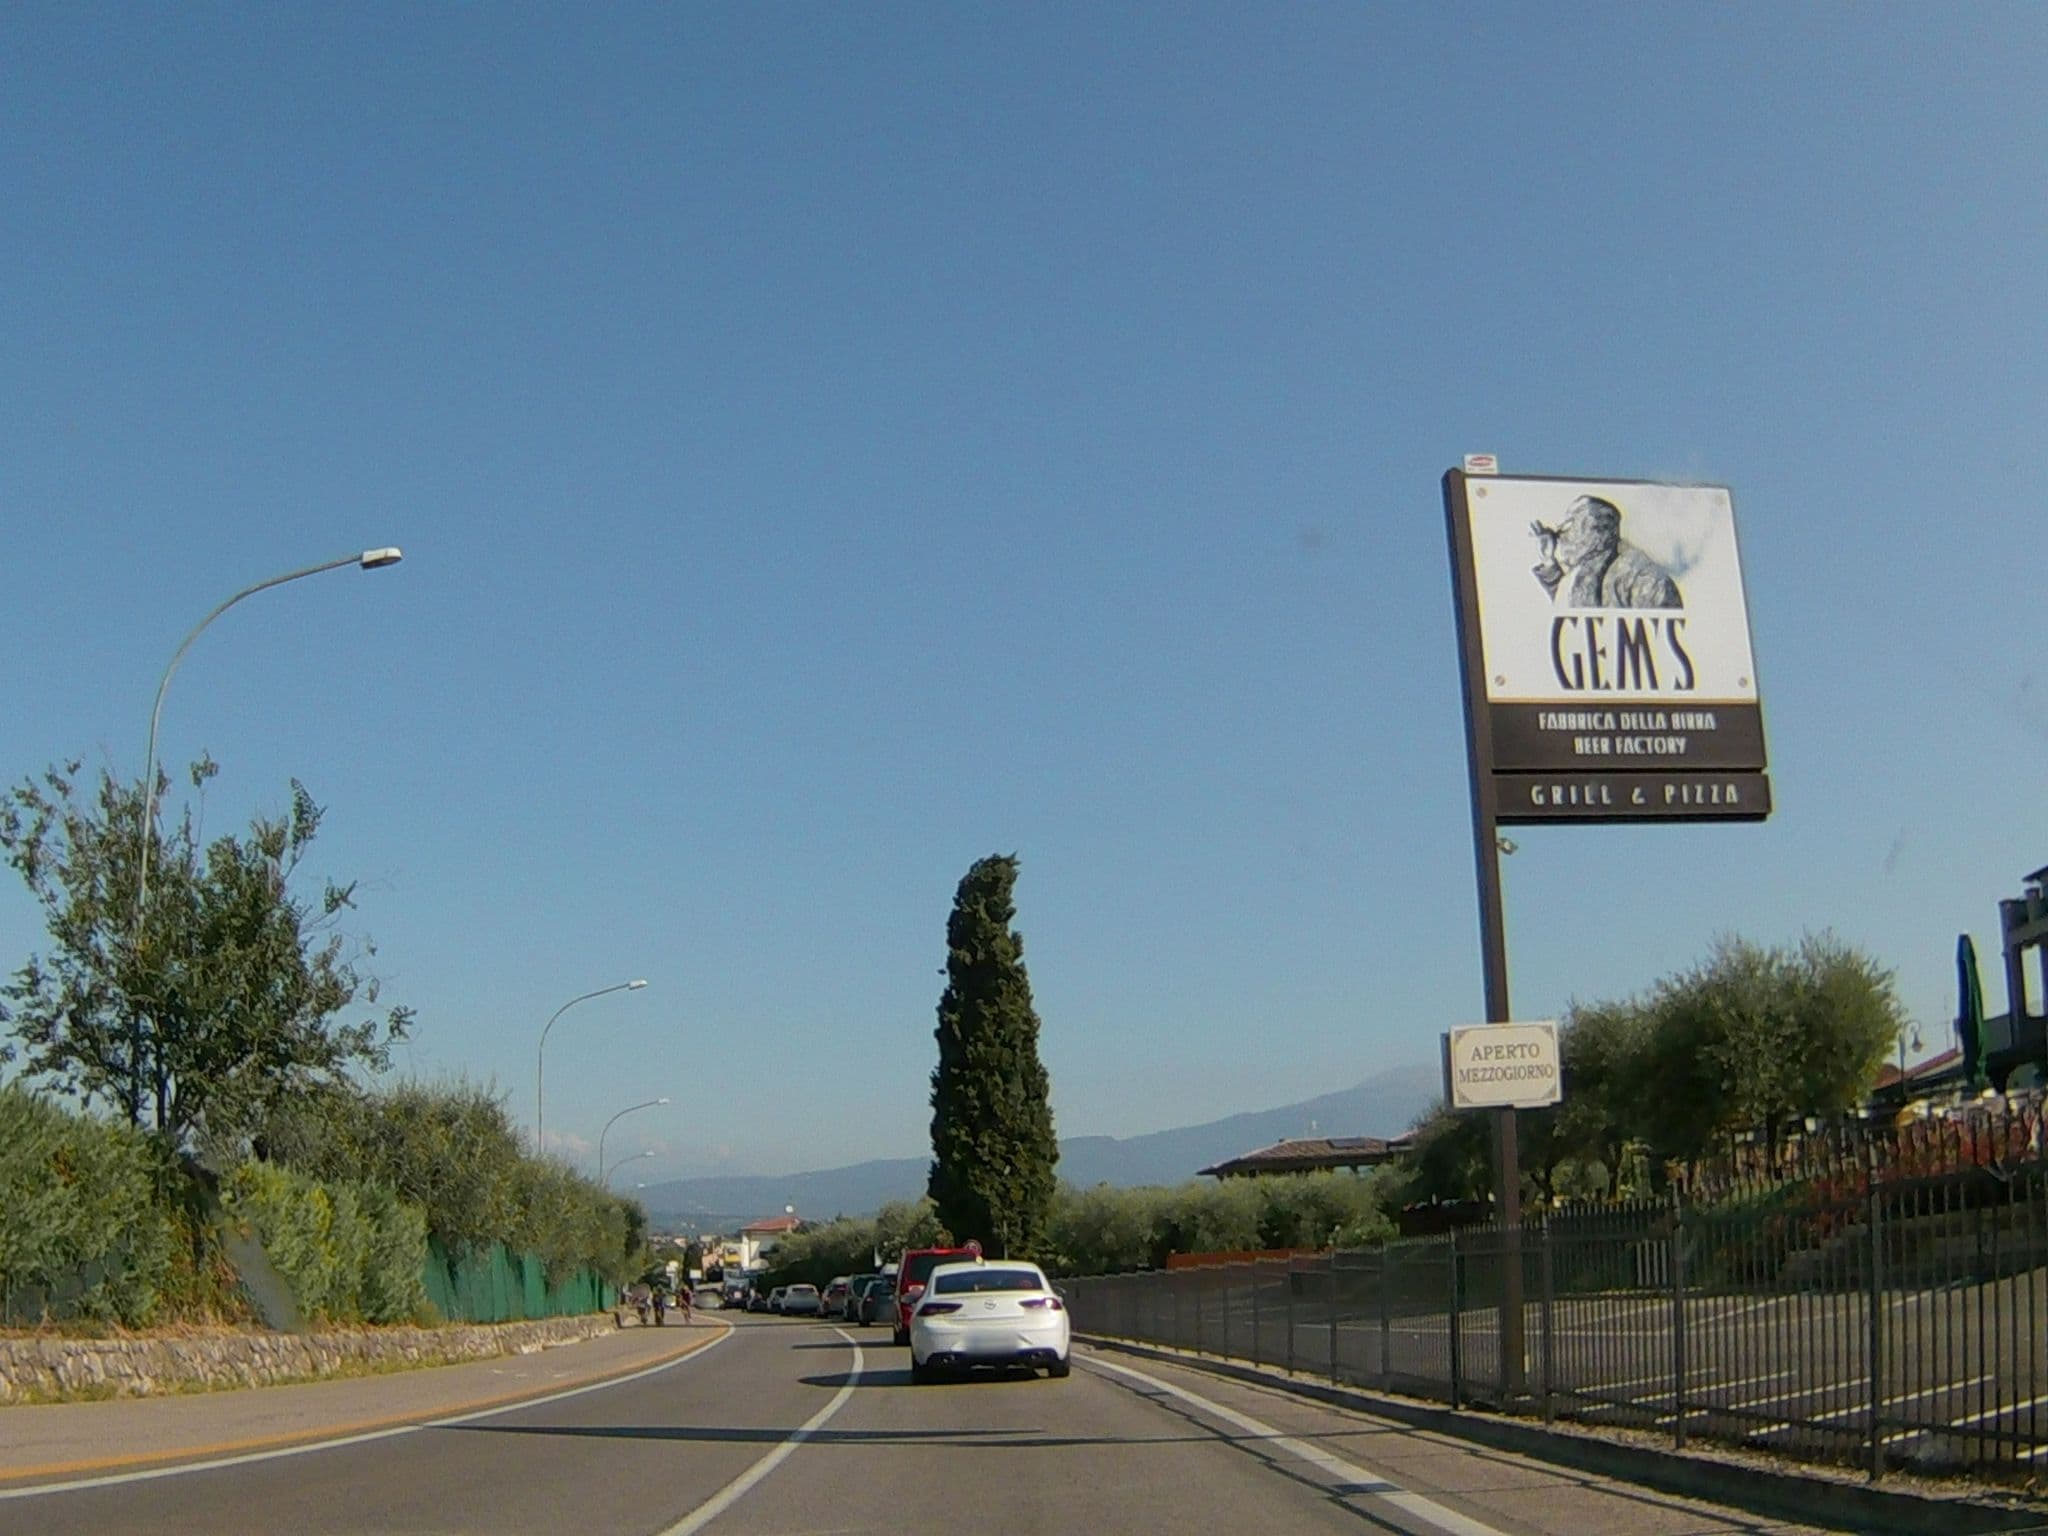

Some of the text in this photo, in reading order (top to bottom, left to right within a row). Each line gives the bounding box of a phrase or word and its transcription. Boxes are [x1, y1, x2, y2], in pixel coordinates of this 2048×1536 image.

[1551, 616, 1696, 691] GEM'S
[1539, 711, 1716, 731] FABBRICA DELLA BIRRA
[1574, 736, 1687, 755] BEER FACTORY
[1531, 784, 1613, 805] GRILL
[1664, 783, 1738, 804] PIZZA
[1472, 1043, 1541, 1061] APERTO
[1459, 1063, 1554, 1083] MEZZOGIORNO
